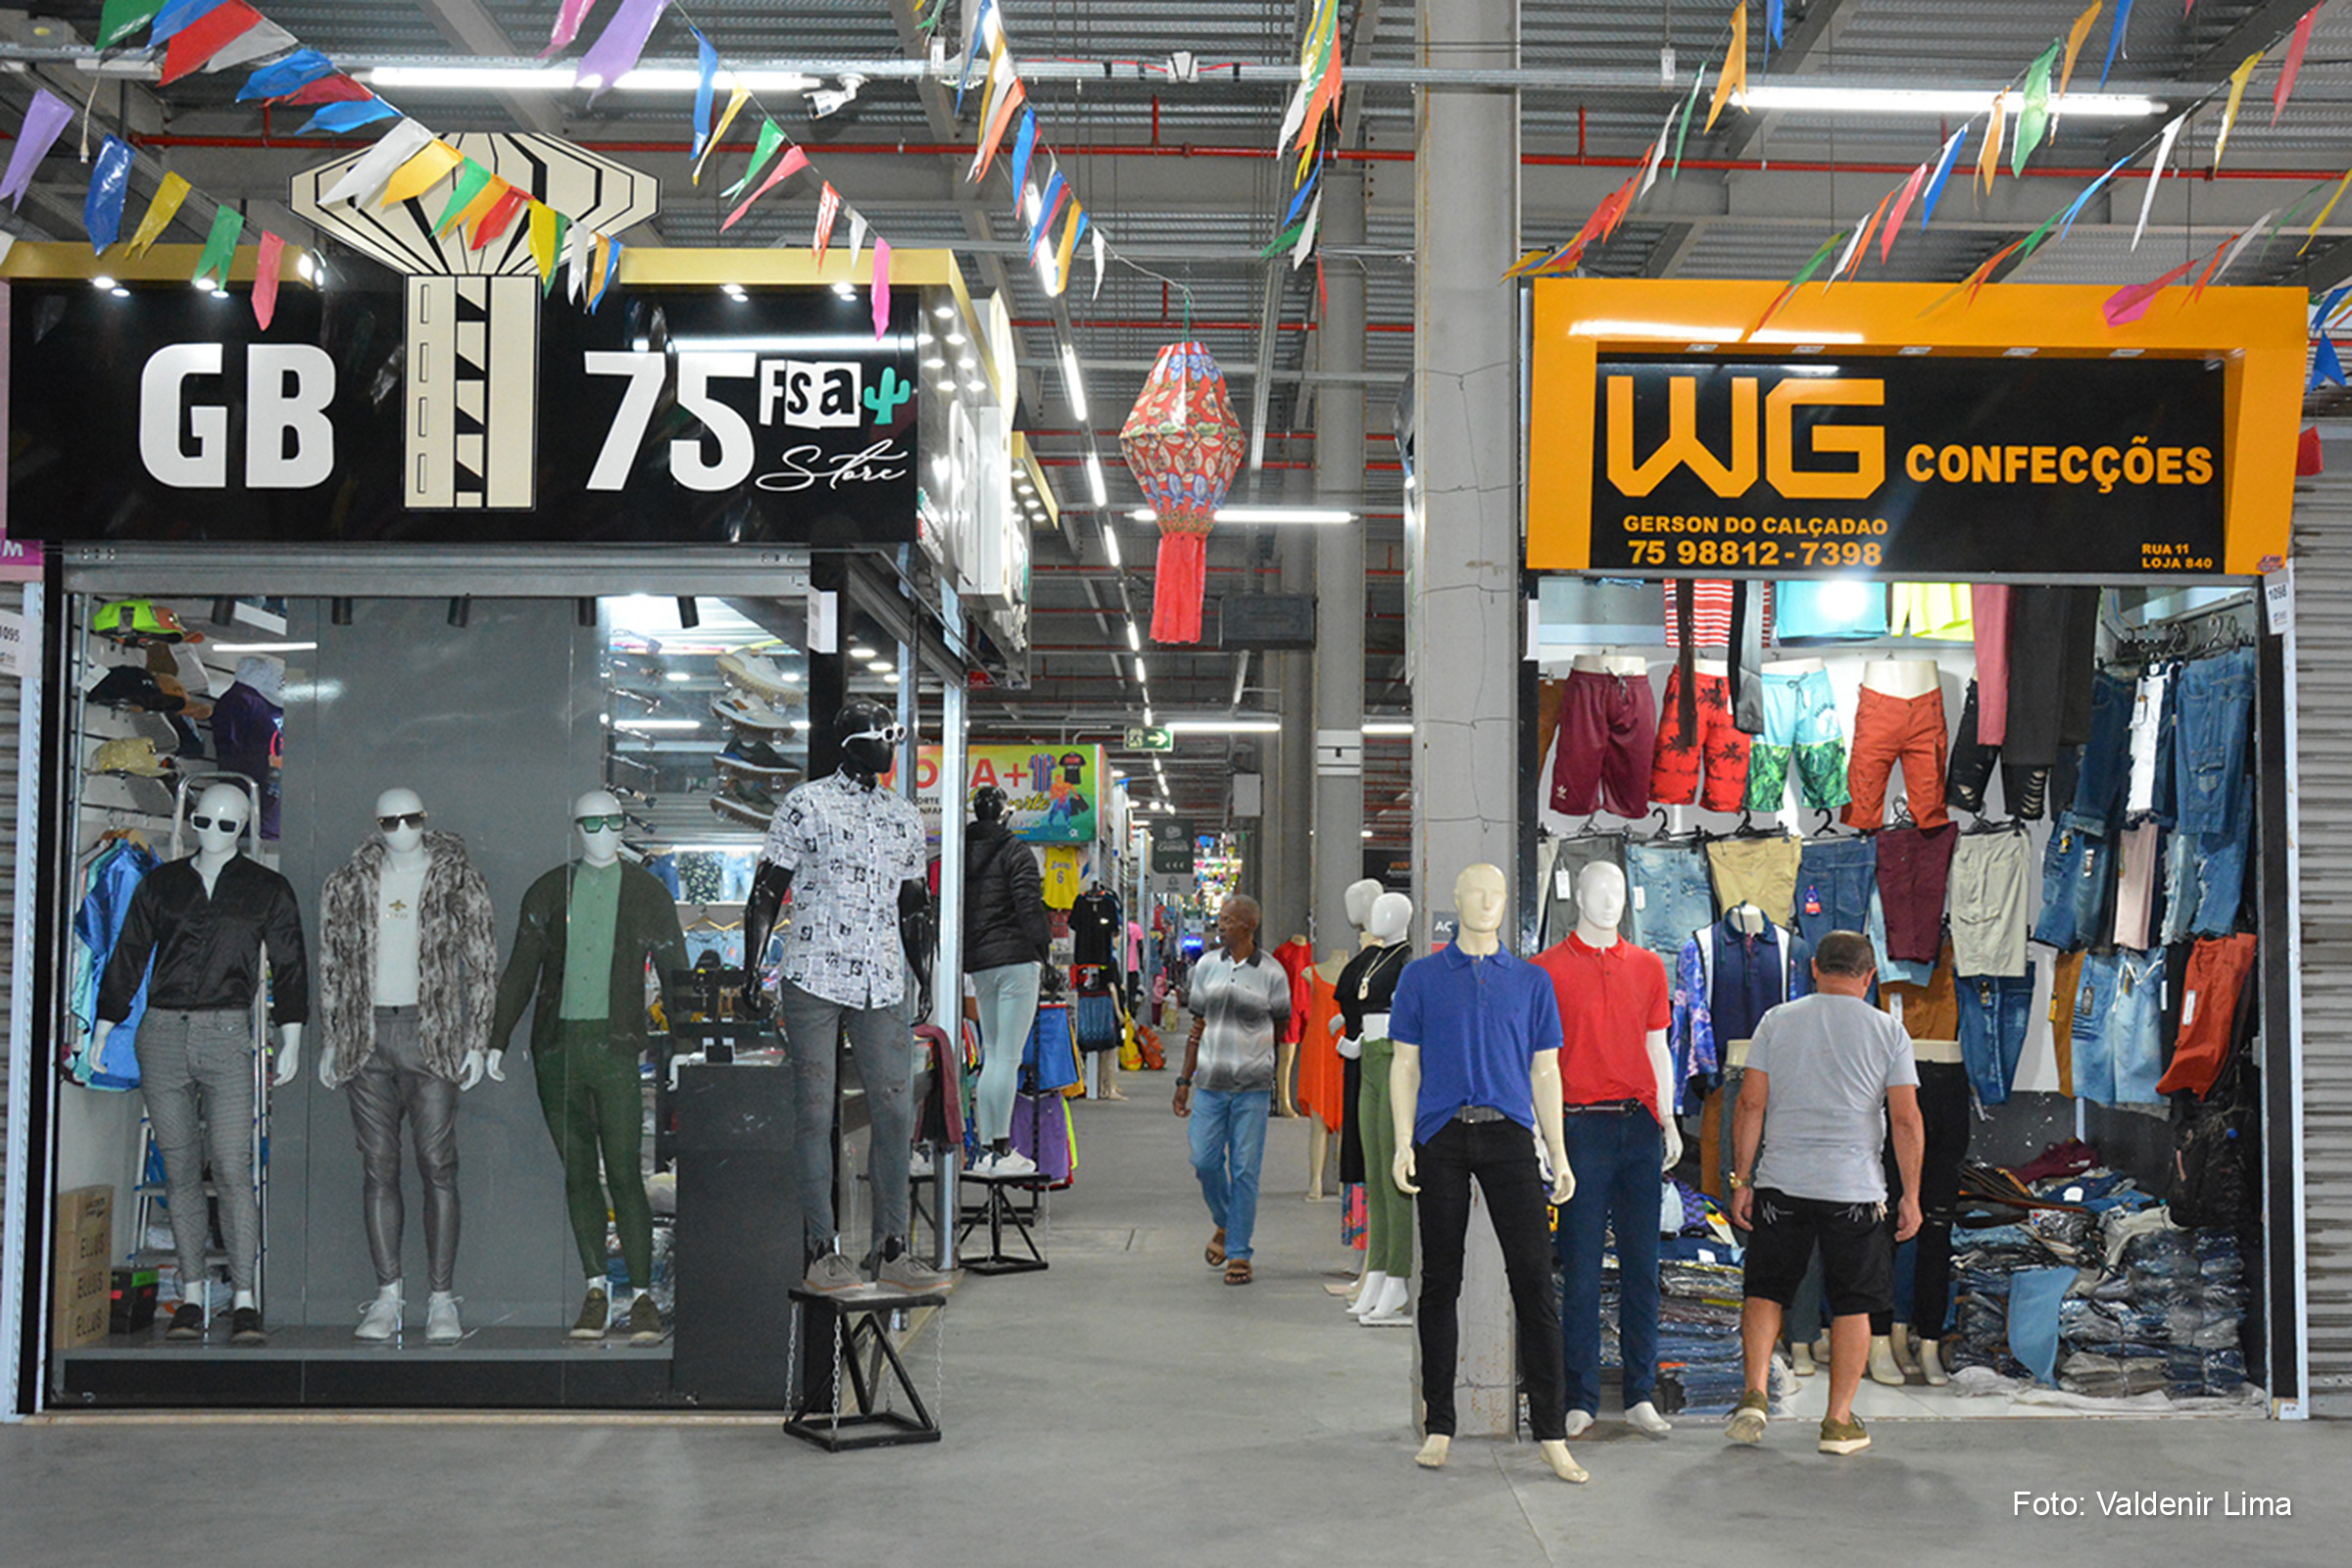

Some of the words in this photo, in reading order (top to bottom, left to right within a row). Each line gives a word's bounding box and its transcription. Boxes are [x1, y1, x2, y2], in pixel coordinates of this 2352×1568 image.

[139, 343, 336, 488] GB
[584, 351, 757, 491] 75
[1606, 376, 1886, 499] WG
[1905, 436, 2214, 494] CONFECÇÕES
[755, 438, 908, 491] Store
[1623, 514, 1719, 534] GERSON
[1725, 516, 1757, 534] DO
[1761, 516, 1888, 538] CALÇADAO
[1628, 540, 1666, 564] 75
[2141, 543, 2173, 556] RUA
[2175, 543, 2189, 555] 11
[2141, 557, 2181, 568] LOJA
[2185, 558, 2213, 569] 840
